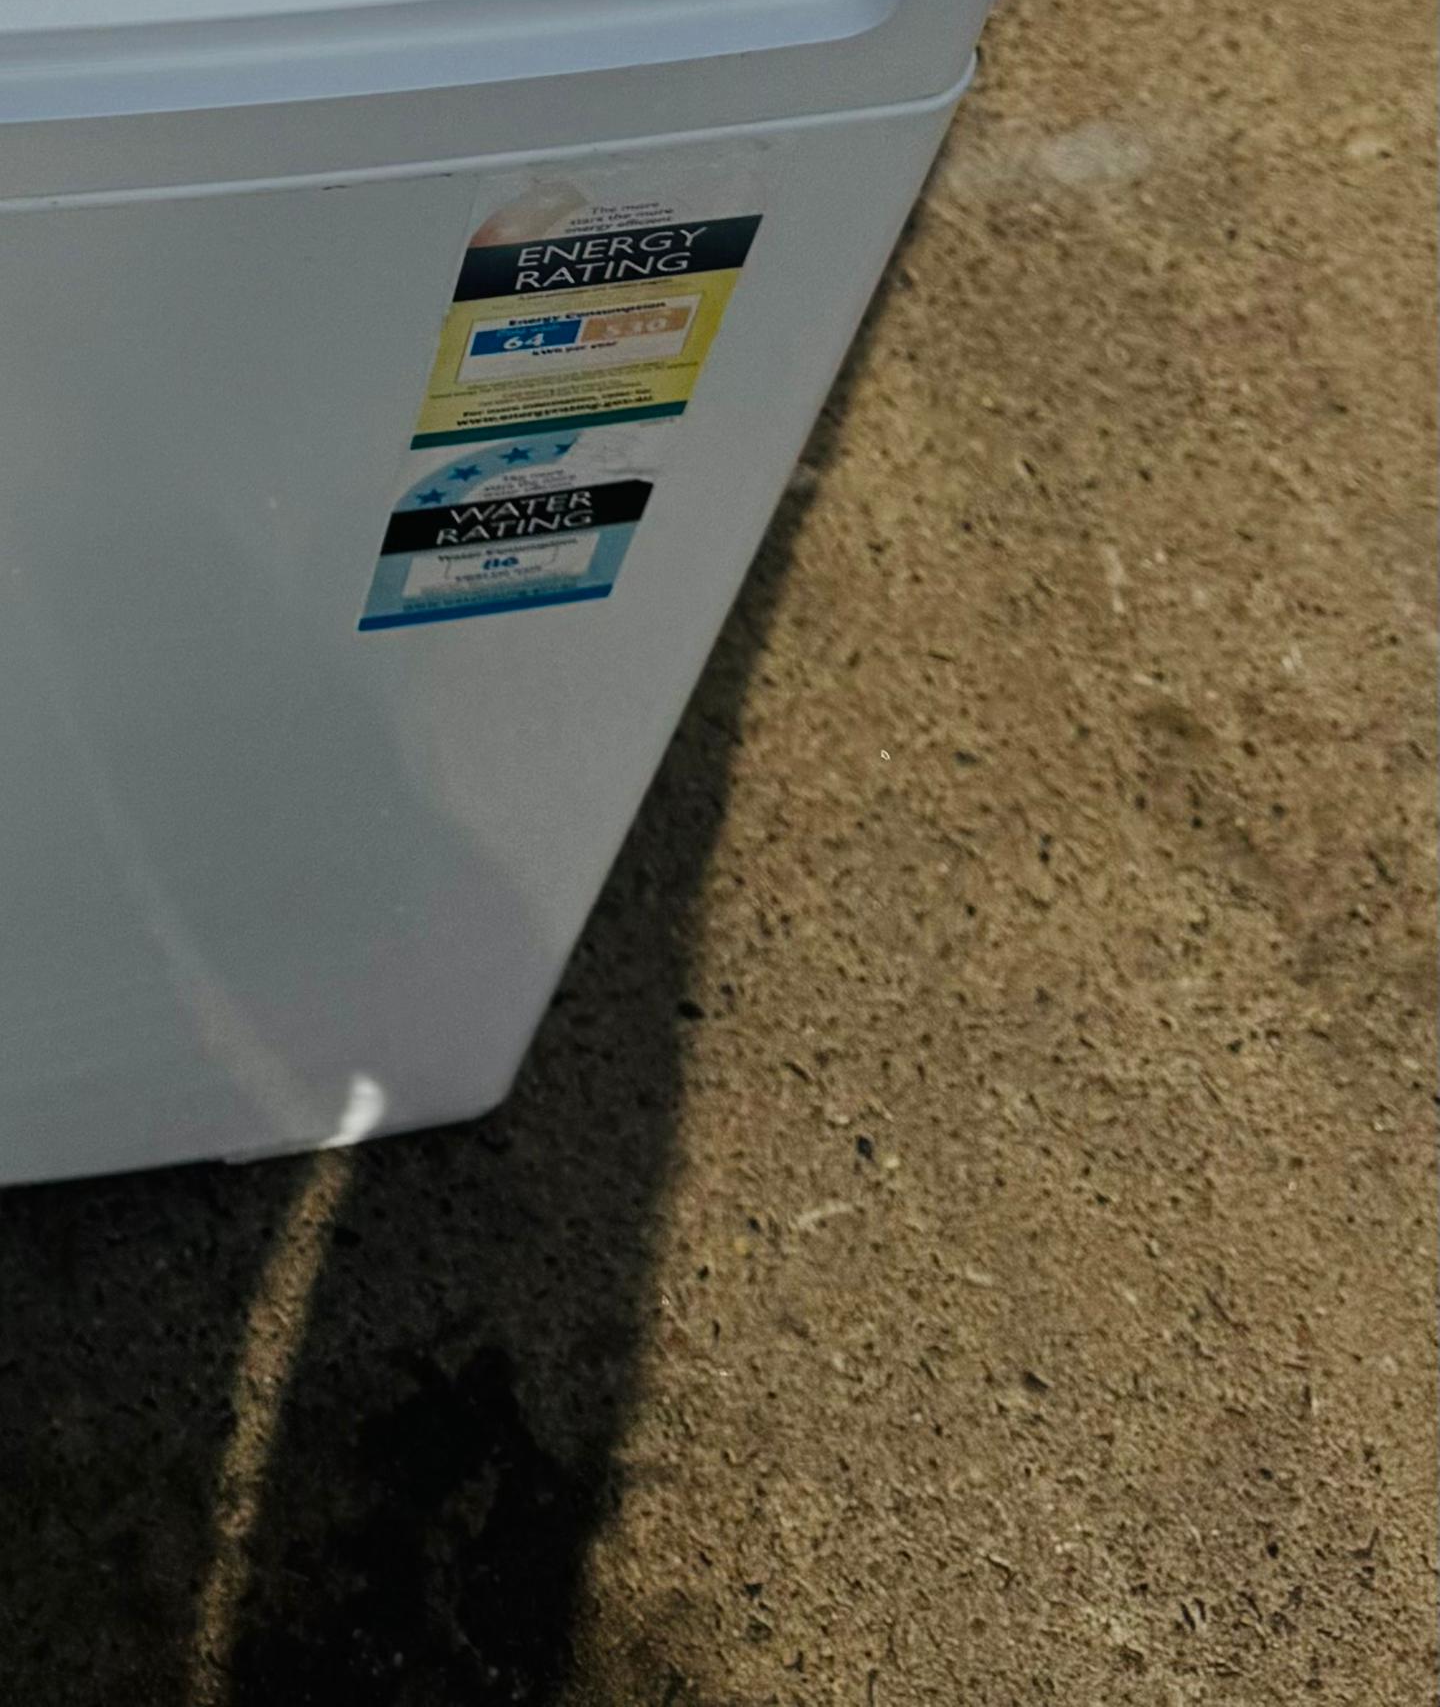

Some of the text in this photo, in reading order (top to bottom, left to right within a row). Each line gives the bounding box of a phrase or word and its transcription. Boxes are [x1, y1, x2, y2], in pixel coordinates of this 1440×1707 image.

[516, 225, 708, 268] ENERGY
[514, 251, 692, 291] RATING
[508, 300, 667, 327] Energy Consumption
[502, 332, 545, 351] 64
[449, 490, 593, 525] WATER
[435, 508, 594, 547] RATING
